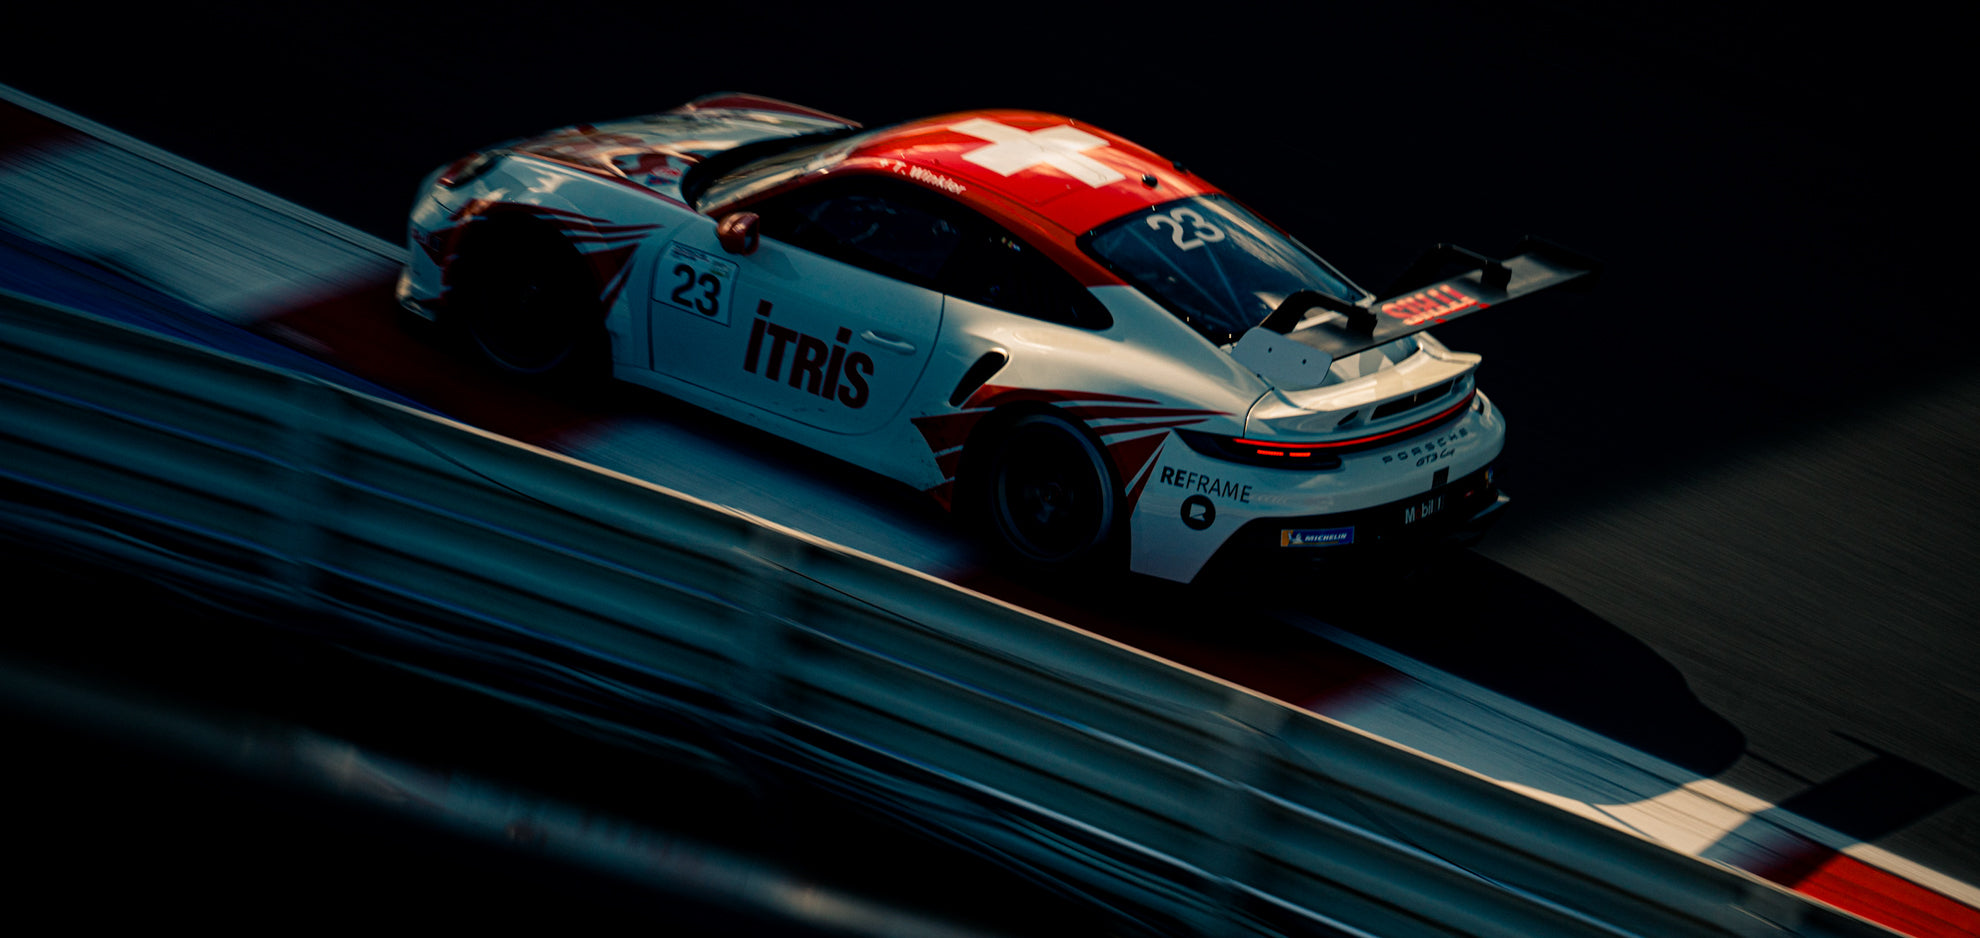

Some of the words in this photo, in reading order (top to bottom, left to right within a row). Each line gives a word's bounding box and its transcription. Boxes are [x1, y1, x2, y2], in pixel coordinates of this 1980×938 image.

[1146, 206, 1226, 252] 23
[671, 264, 721, 317] 23
[1382, 427, 1468, 464] PORSCHE
[1416, 452, 1438, 467] GT3
[1160, 465, 1253, 504] REFRAME
[1404, 497, 1434, 526] Mobil
[1304, 533, 1348, 541] MICHELIN
